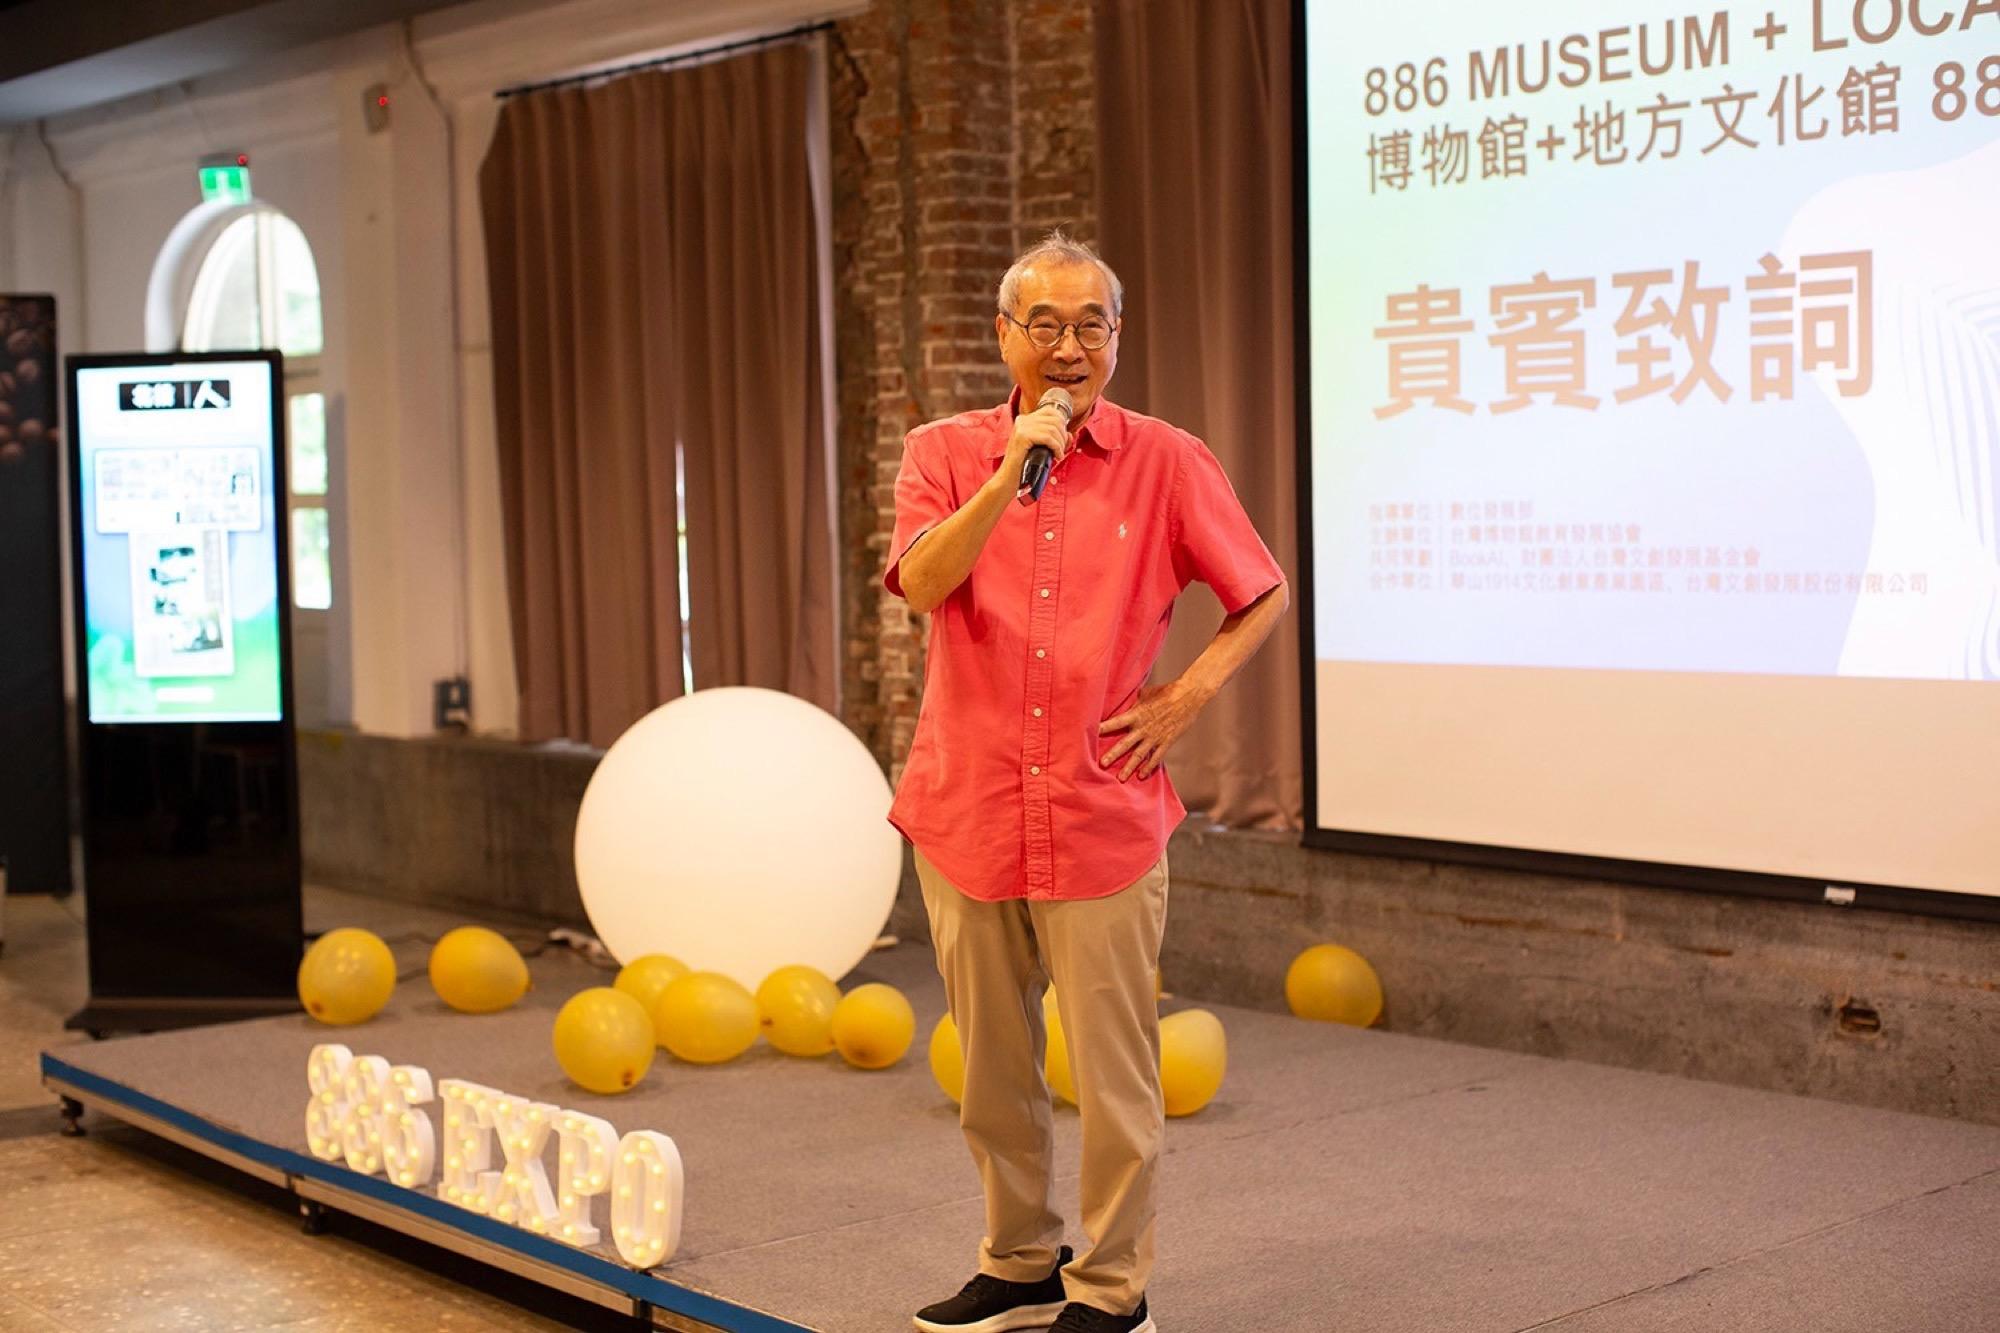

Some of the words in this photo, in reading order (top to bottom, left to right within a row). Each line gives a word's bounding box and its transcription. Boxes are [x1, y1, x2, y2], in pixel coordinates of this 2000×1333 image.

[1364, 57, 1449, 116] 886
[1469, 12, 1729, 101] MUSEUM
[1753, 12, 1787, 50] +
[1367, 61, 1901, 195] 博物館+地方文化館
[1373, 250, 1874, 421] 貴賓致詞
[306, 1043, 435, 1189] 886
[438, 1079, 684, 1267] EXPO
